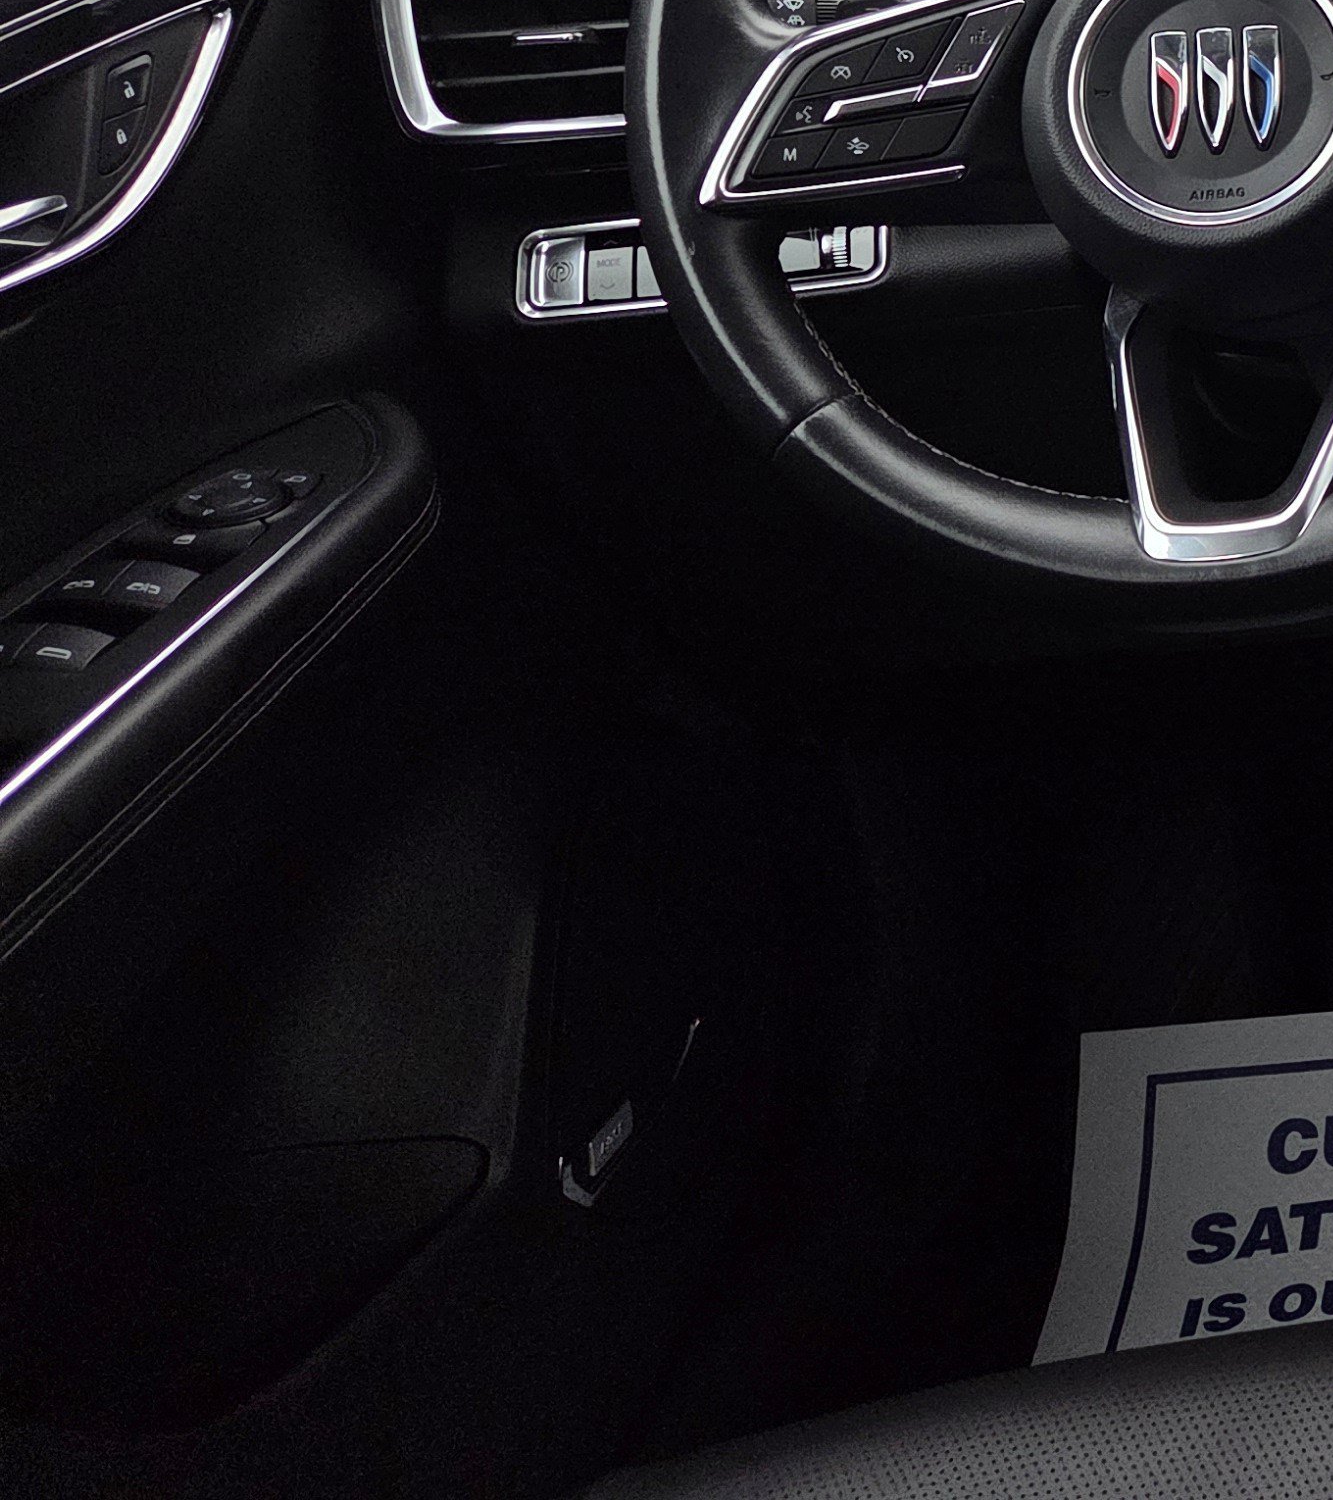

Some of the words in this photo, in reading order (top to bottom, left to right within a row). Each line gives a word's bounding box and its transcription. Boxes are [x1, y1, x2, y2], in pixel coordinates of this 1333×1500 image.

[782, 147, 797, 162] M
[1188, 186, 1246, 202] AIRBAG
[1178, 1296, 1247, 1338] IS
